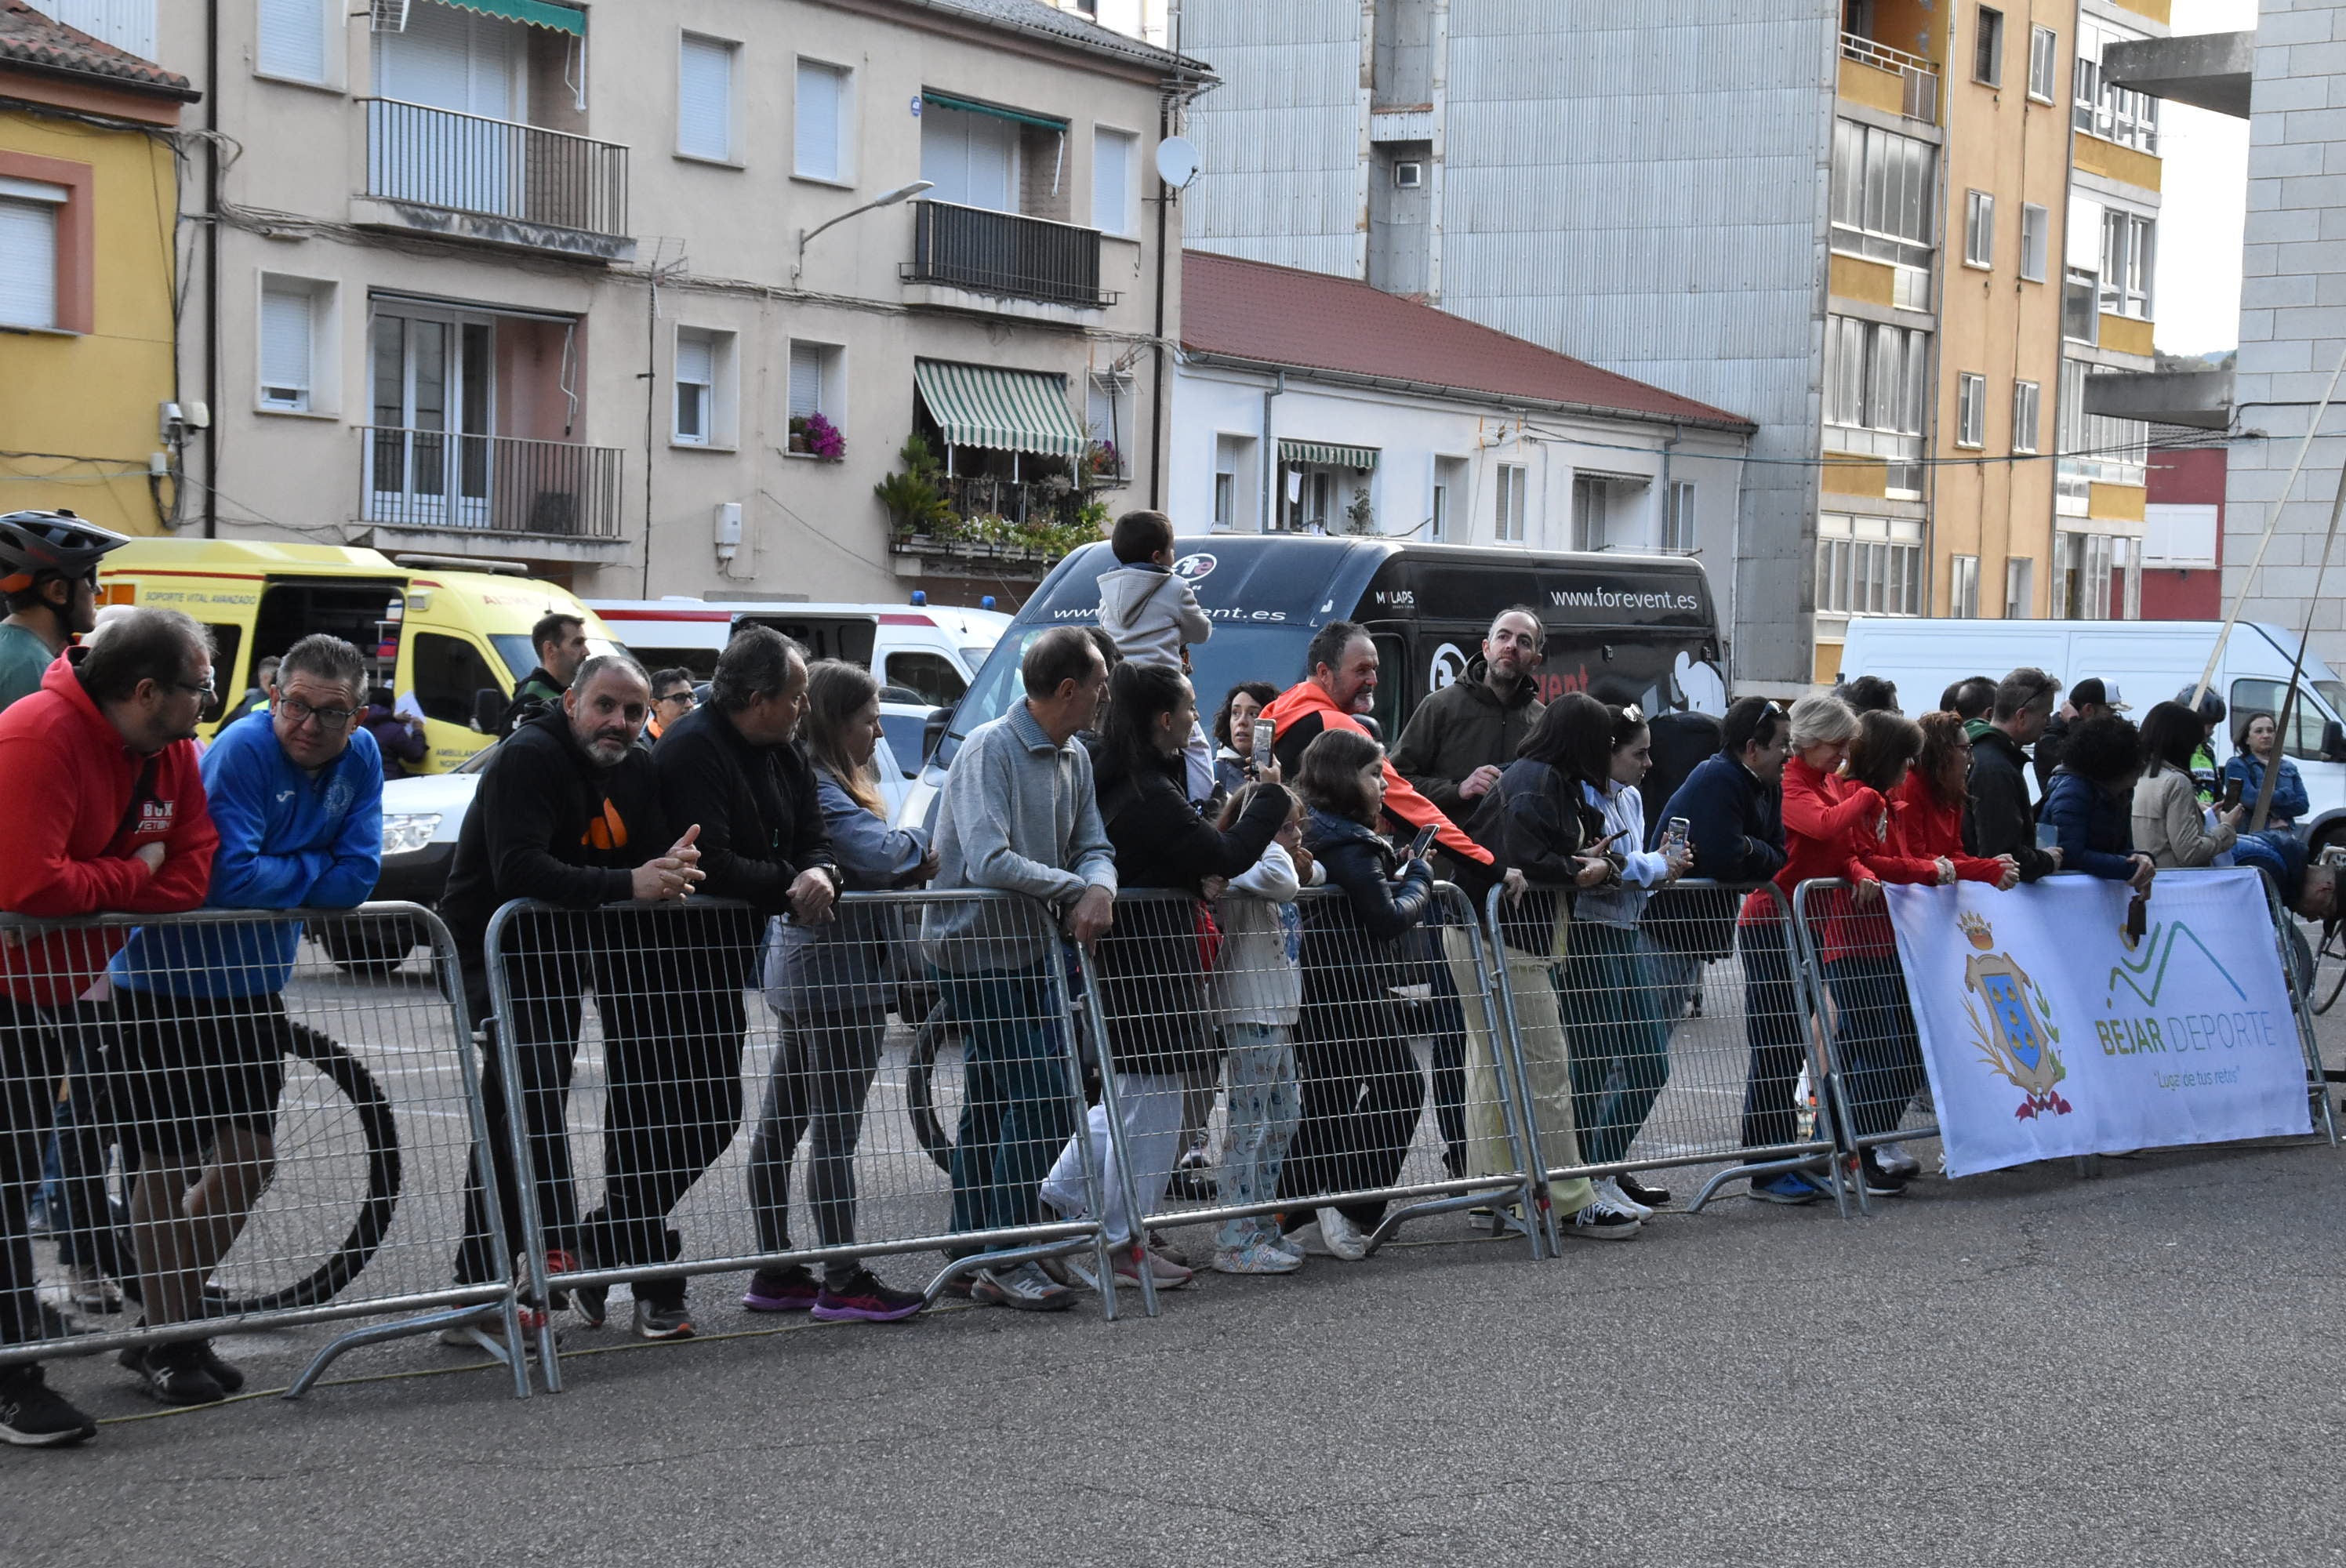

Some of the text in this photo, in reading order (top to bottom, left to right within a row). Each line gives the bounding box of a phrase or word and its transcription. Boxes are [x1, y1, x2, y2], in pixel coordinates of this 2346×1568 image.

[144, 591, 257, 605] SOPORTE VITAL AVANZADO
[1550, 586, 1698, 610] www.forevent.es
[2167, 1011, 2276, 1052] DEPORTE
[2196, 1071, 2212, 1086] tus
